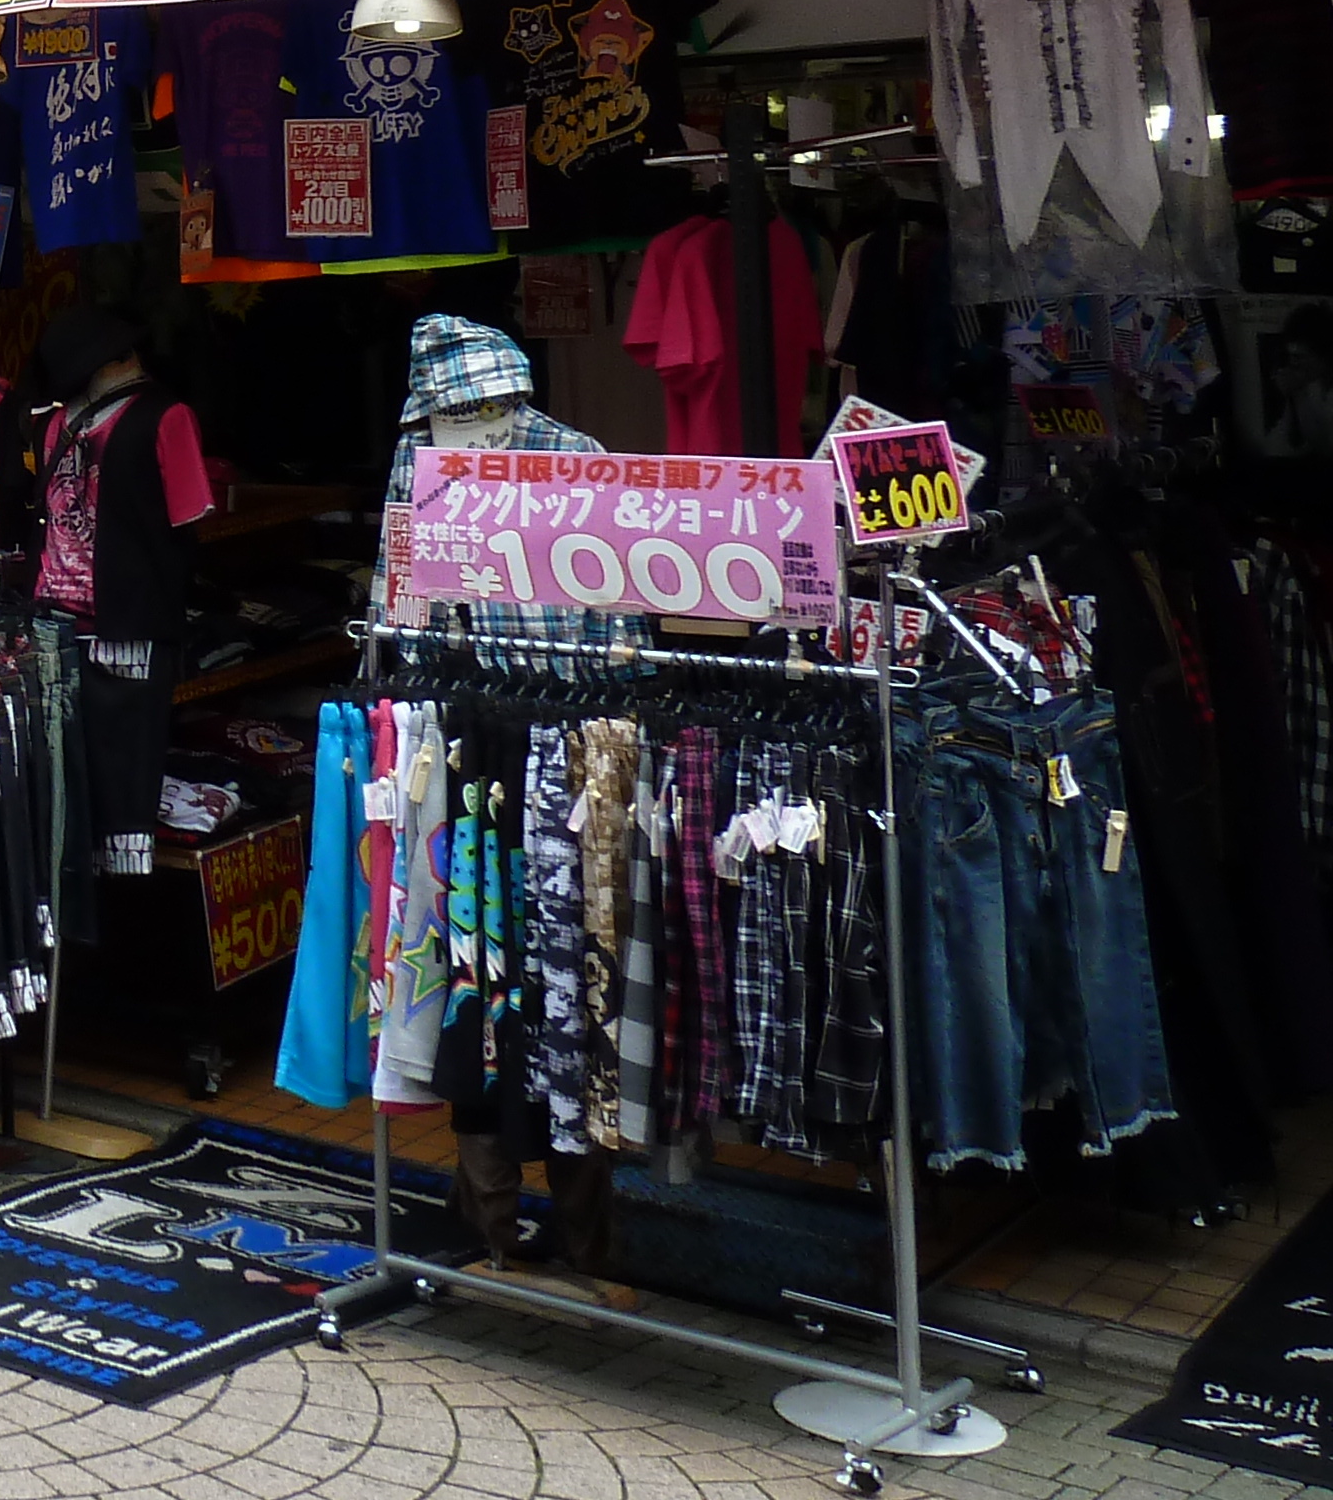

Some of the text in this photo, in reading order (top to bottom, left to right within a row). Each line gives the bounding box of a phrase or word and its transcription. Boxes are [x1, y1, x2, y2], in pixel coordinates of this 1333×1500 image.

[290, 124, 364, 143] 店内全品
[292, 197, 352, 224] ¥1000
[438, 453, 804, 493] 本日限りの店頭プライス
[414, 522, 484, 542] 女性にも
[459, 530, 784, 618] ¥1000
[214, 890, 302, 973] ¥500
[11, 1280, 205, 1340] Stylish
[18, 1309, 170, 1361] Wear
